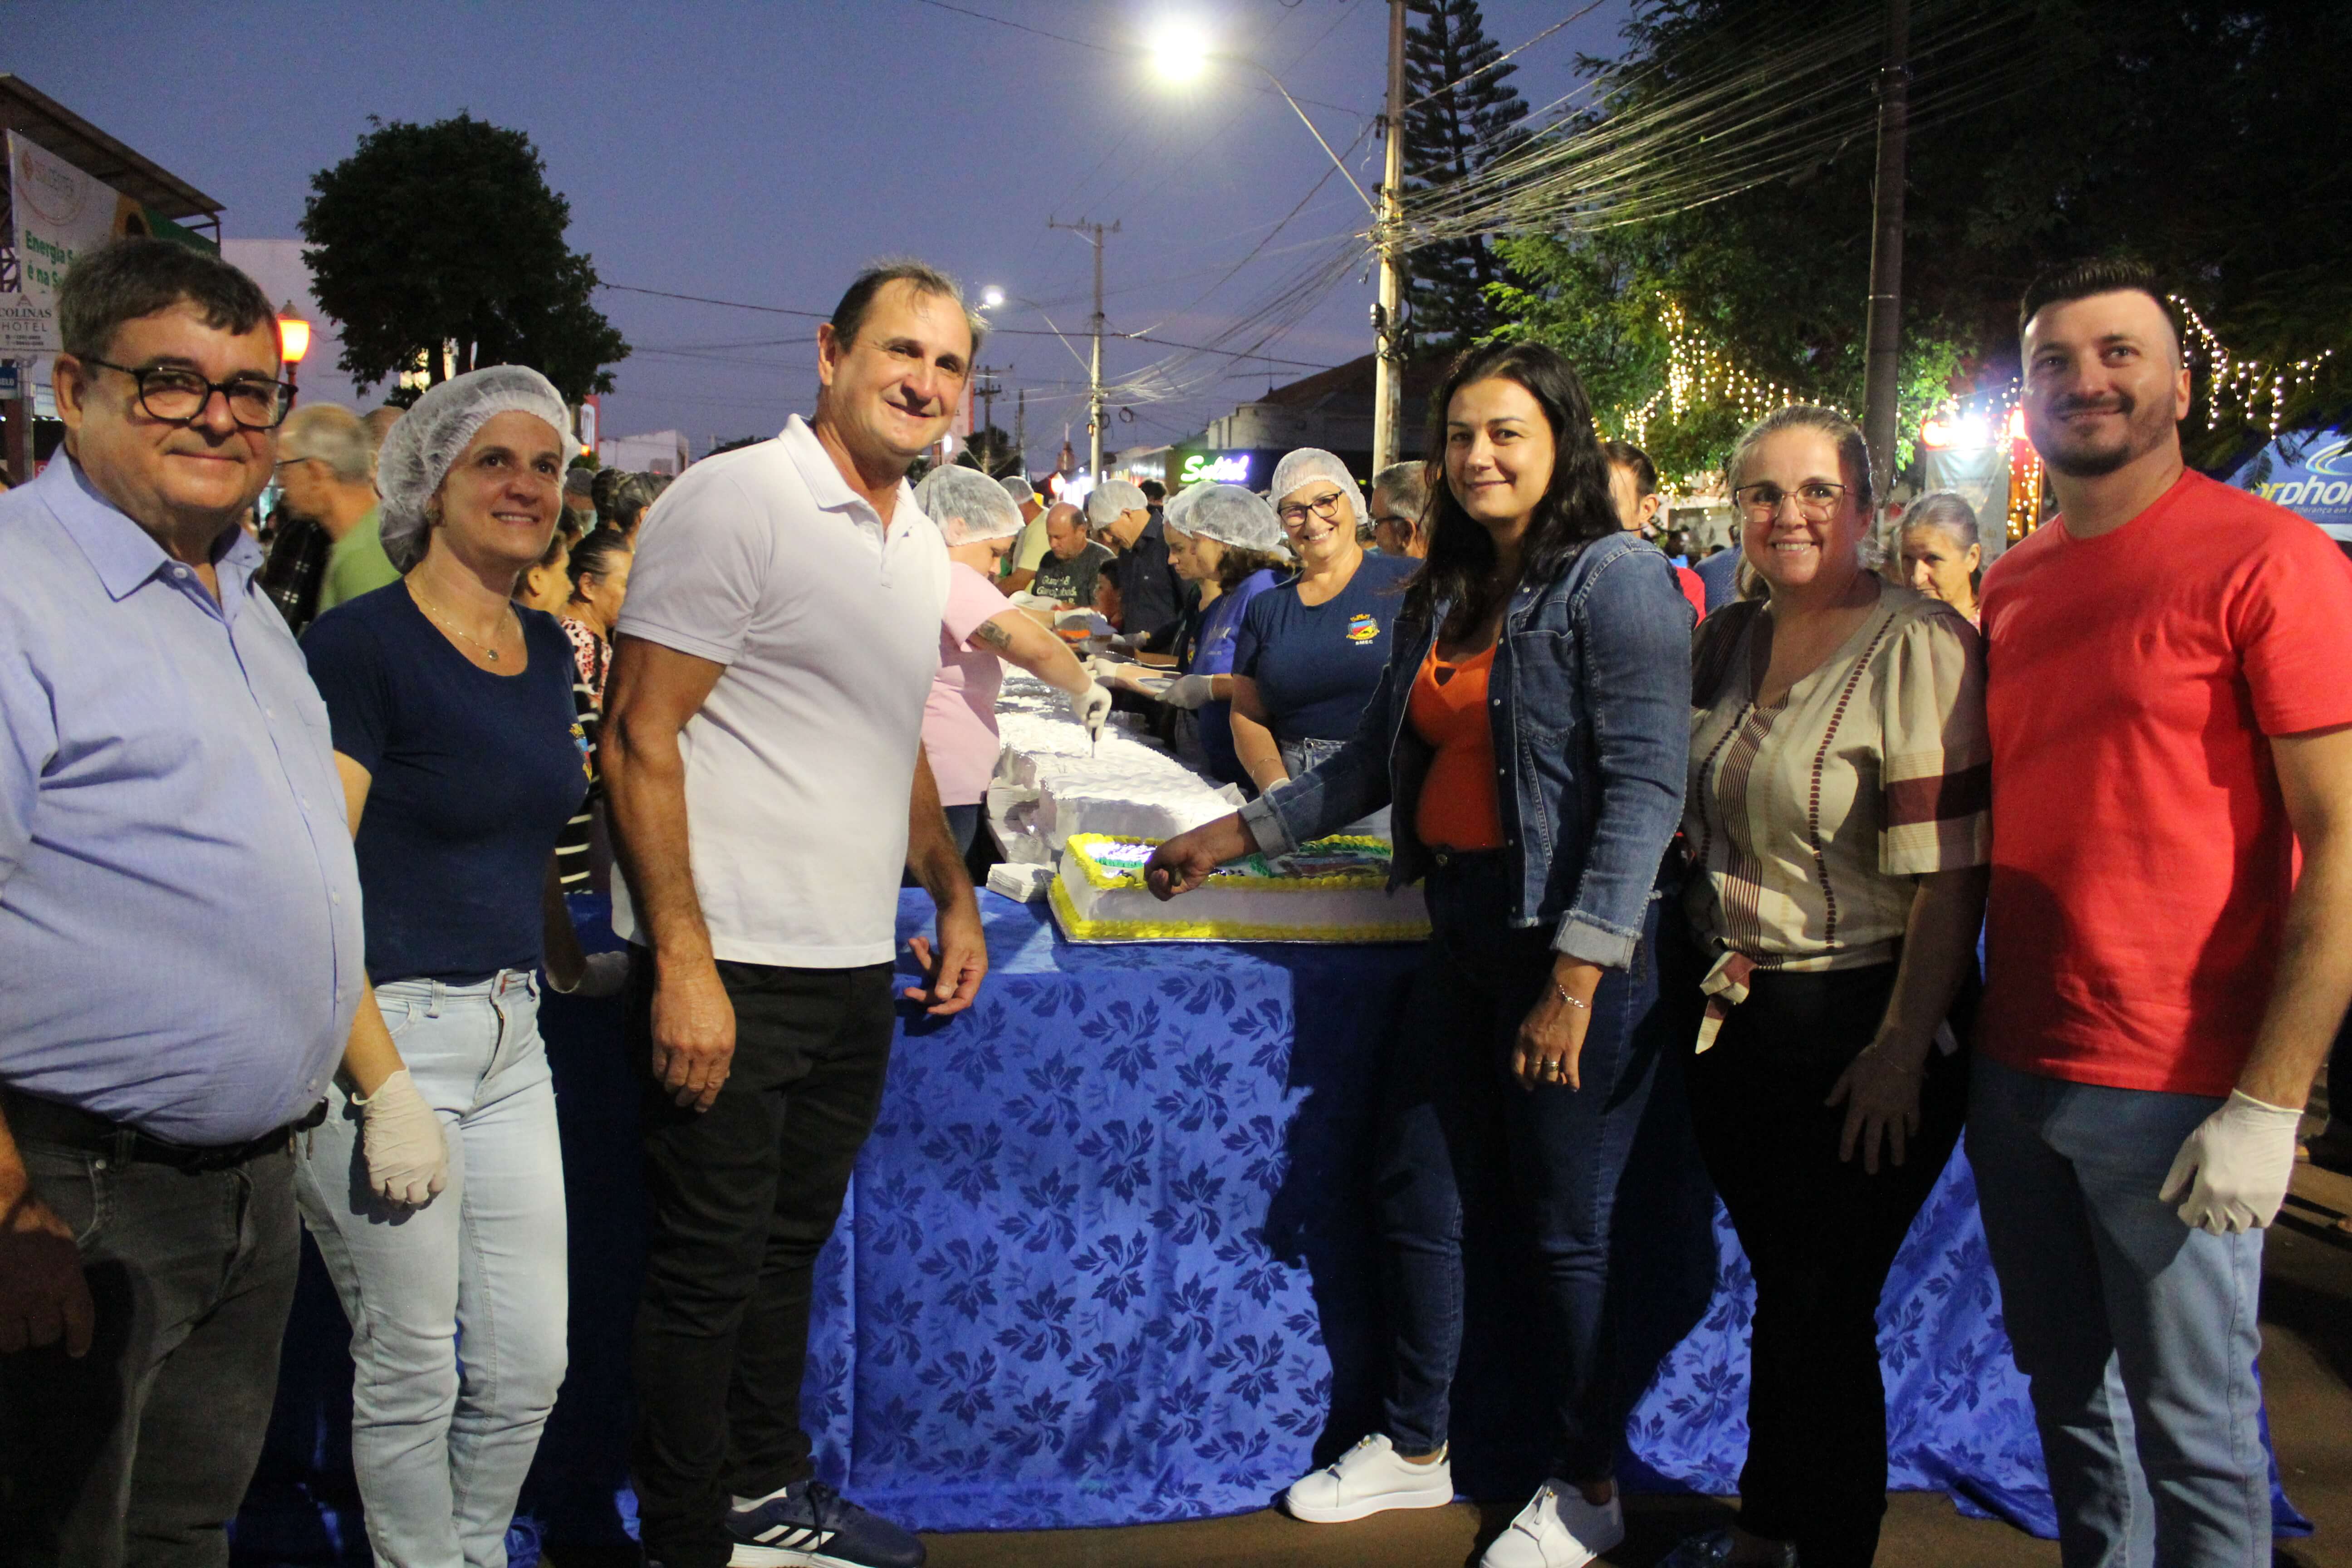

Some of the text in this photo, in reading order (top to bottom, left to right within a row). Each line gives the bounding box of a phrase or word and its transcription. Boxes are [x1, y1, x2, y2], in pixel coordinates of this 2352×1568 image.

[25, 230, 65, 265] Energia
[37, 268, 49, 286] na
[2, 322, 47, 332] HOTEL
